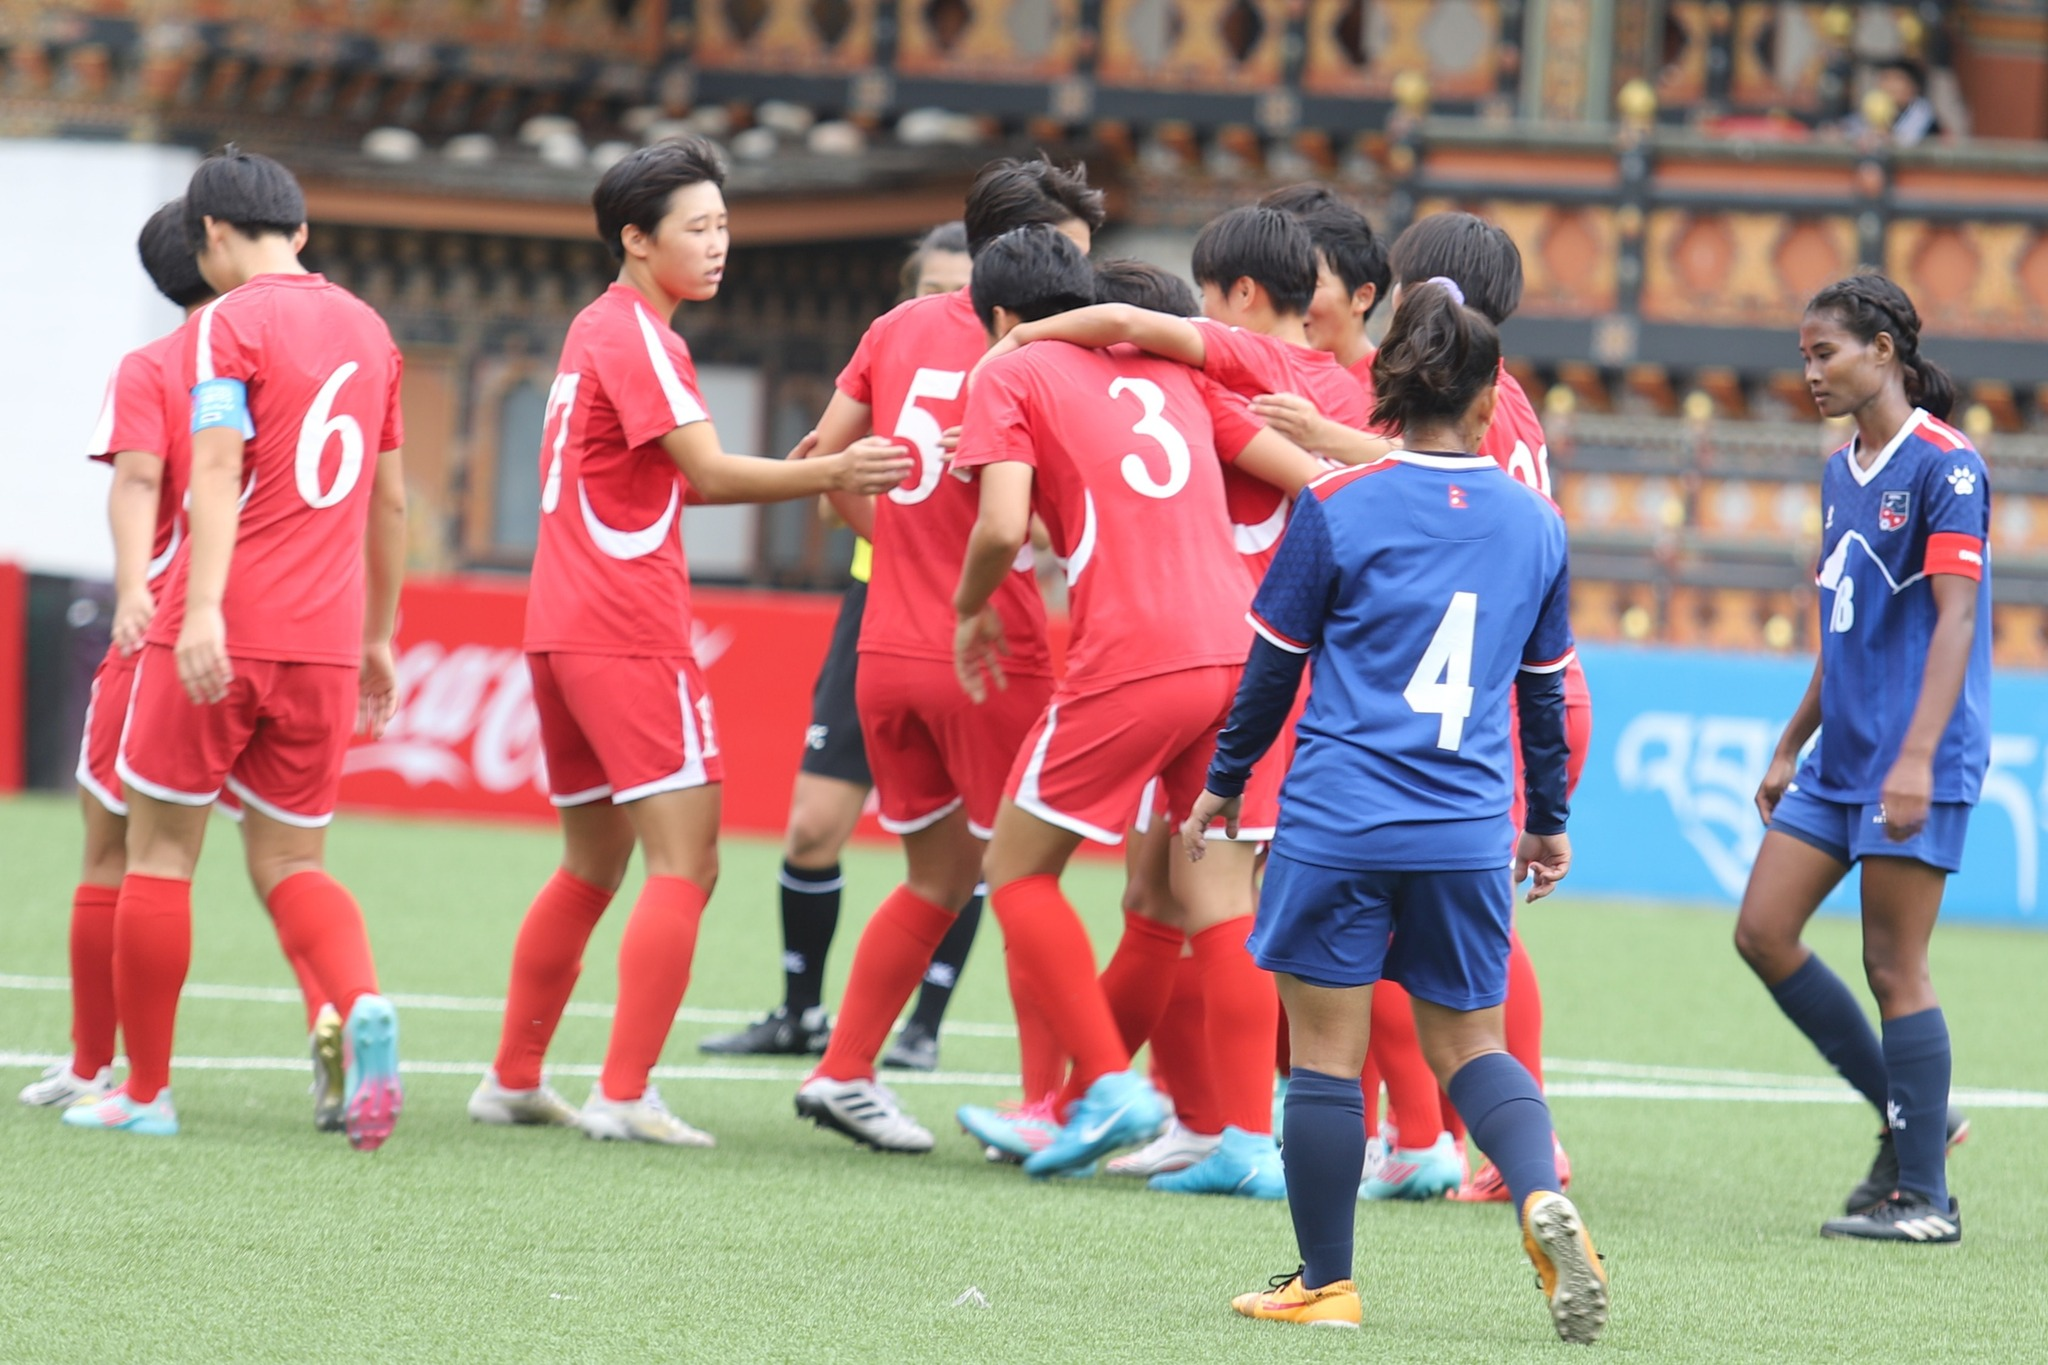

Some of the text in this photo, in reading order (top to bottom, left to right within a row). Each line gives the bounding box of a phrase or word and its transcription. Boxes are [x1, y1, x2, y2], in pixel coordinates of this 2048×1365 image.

[295, 361, 364, 509] 6
[887, 367, 966, 505] 5
[1108, 376, 1191, 499] 3
[1402, 591, 1478, 752] 4
